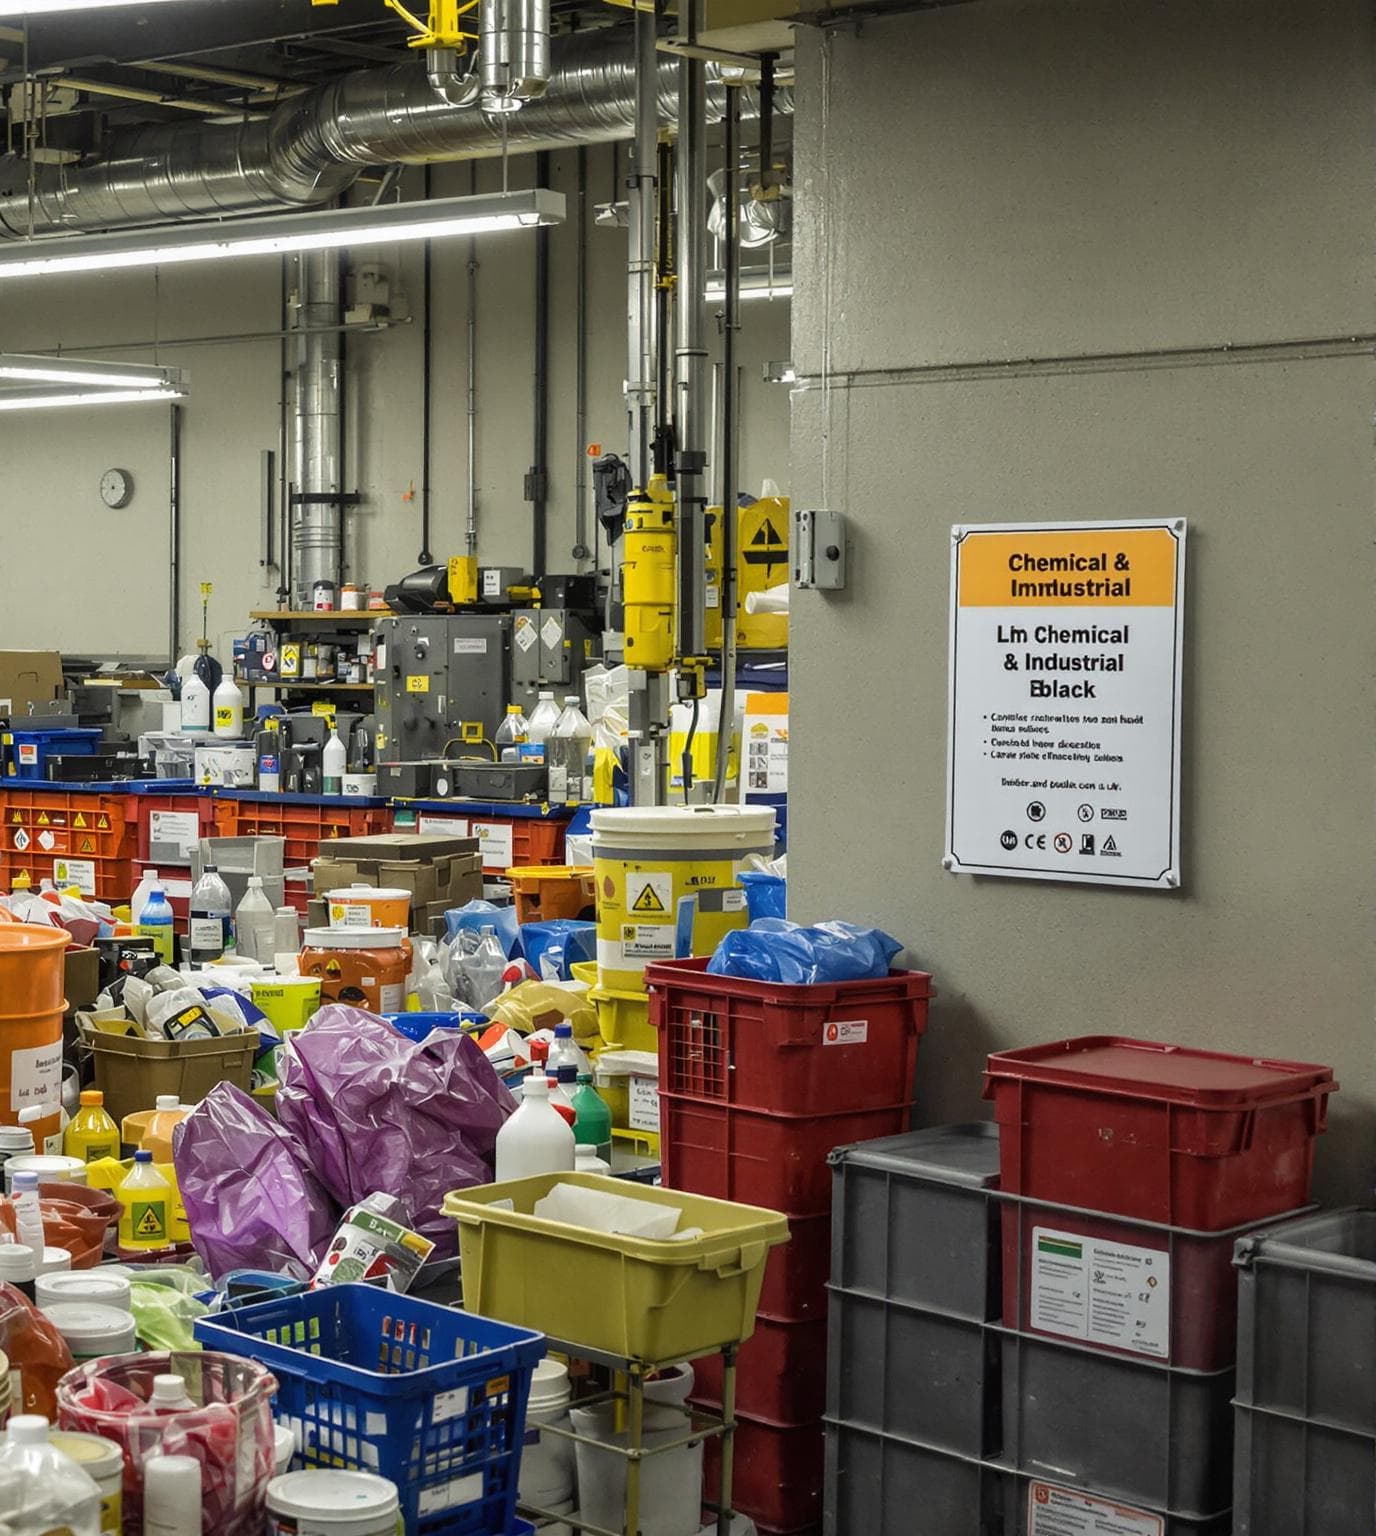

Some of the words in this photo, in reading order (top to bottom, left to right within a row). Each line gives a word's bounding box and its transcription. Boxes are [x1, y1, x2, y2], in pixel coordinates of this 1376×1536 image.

[1008, 553, 1107, 572] Chemical
[1114, 553, 1130, 572] &
[1034, 625, 1129, 644] Chemical
[1003, 653, 1019, 671] &
[1025, 653, 1124, 672] Industrial
